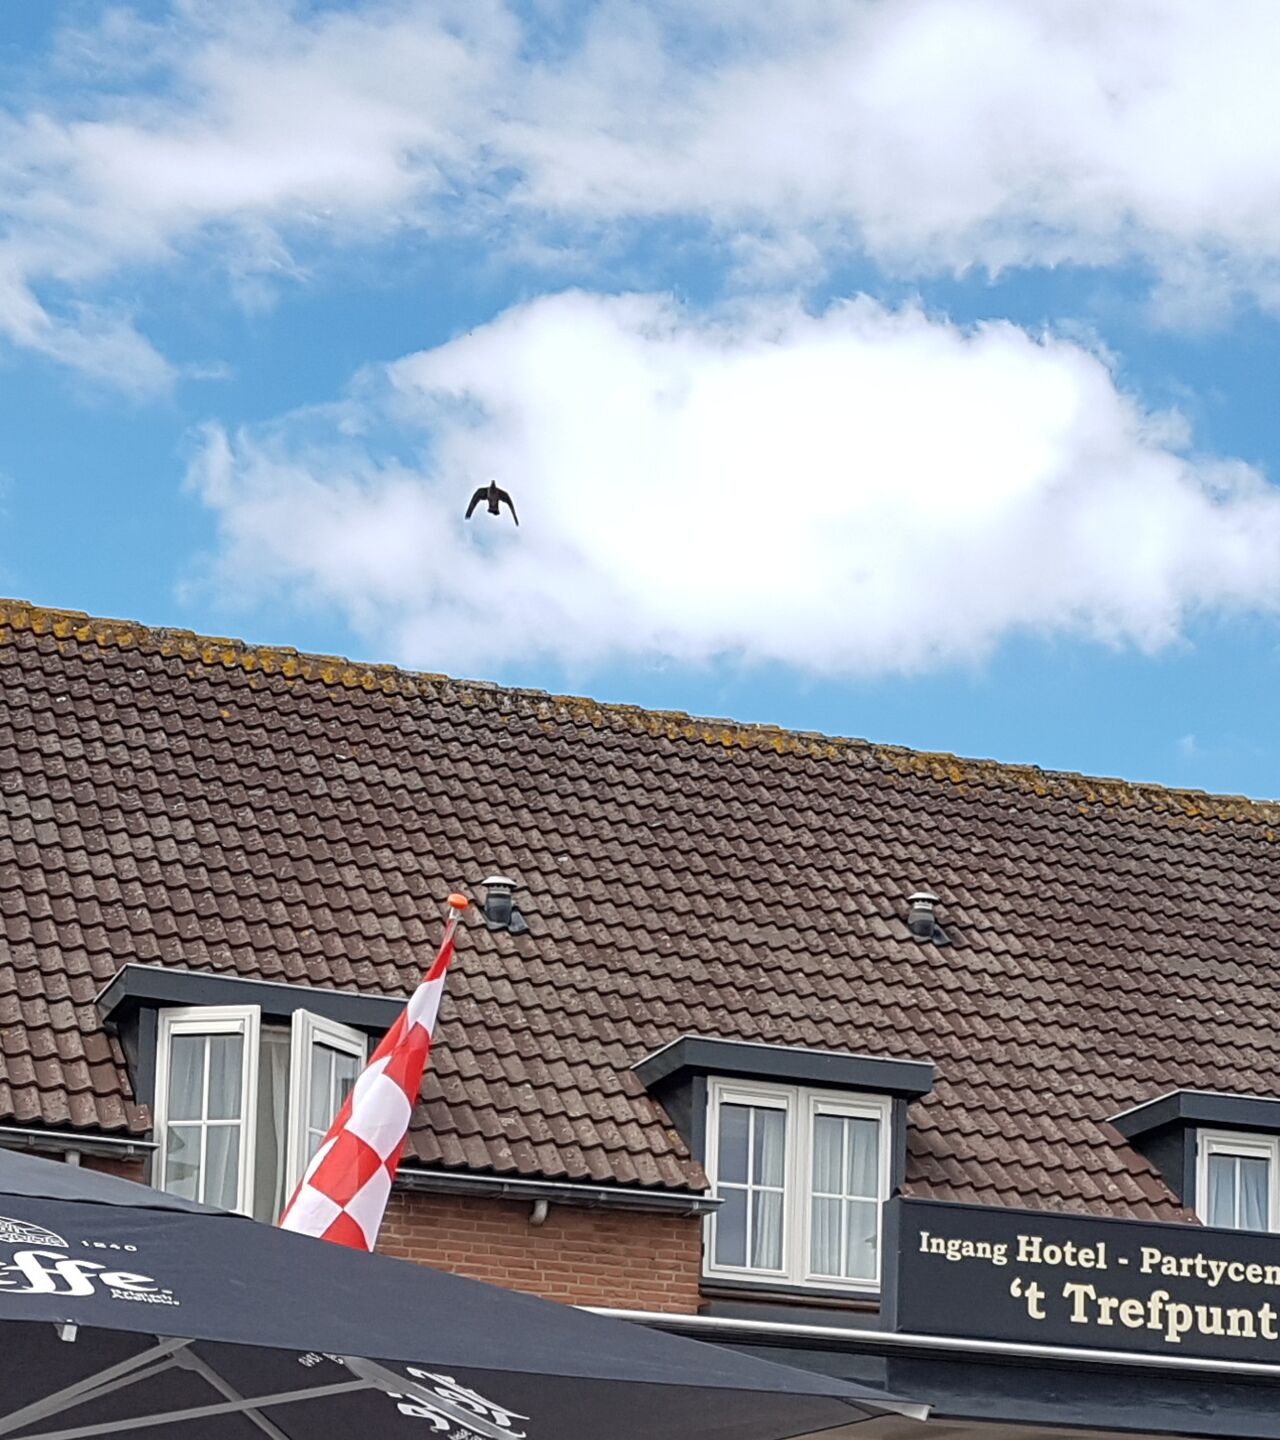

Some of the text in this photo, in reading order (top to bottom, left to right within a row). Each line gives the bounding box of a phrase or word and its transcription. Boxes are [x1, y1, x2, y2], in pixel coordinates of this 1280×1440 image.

[919, 1231, 1008, 1266] Ingang
[1016, 1235, 1108, 1270] Hotel
[1010, 1277, 1279, 1343] 't Trefpunt
